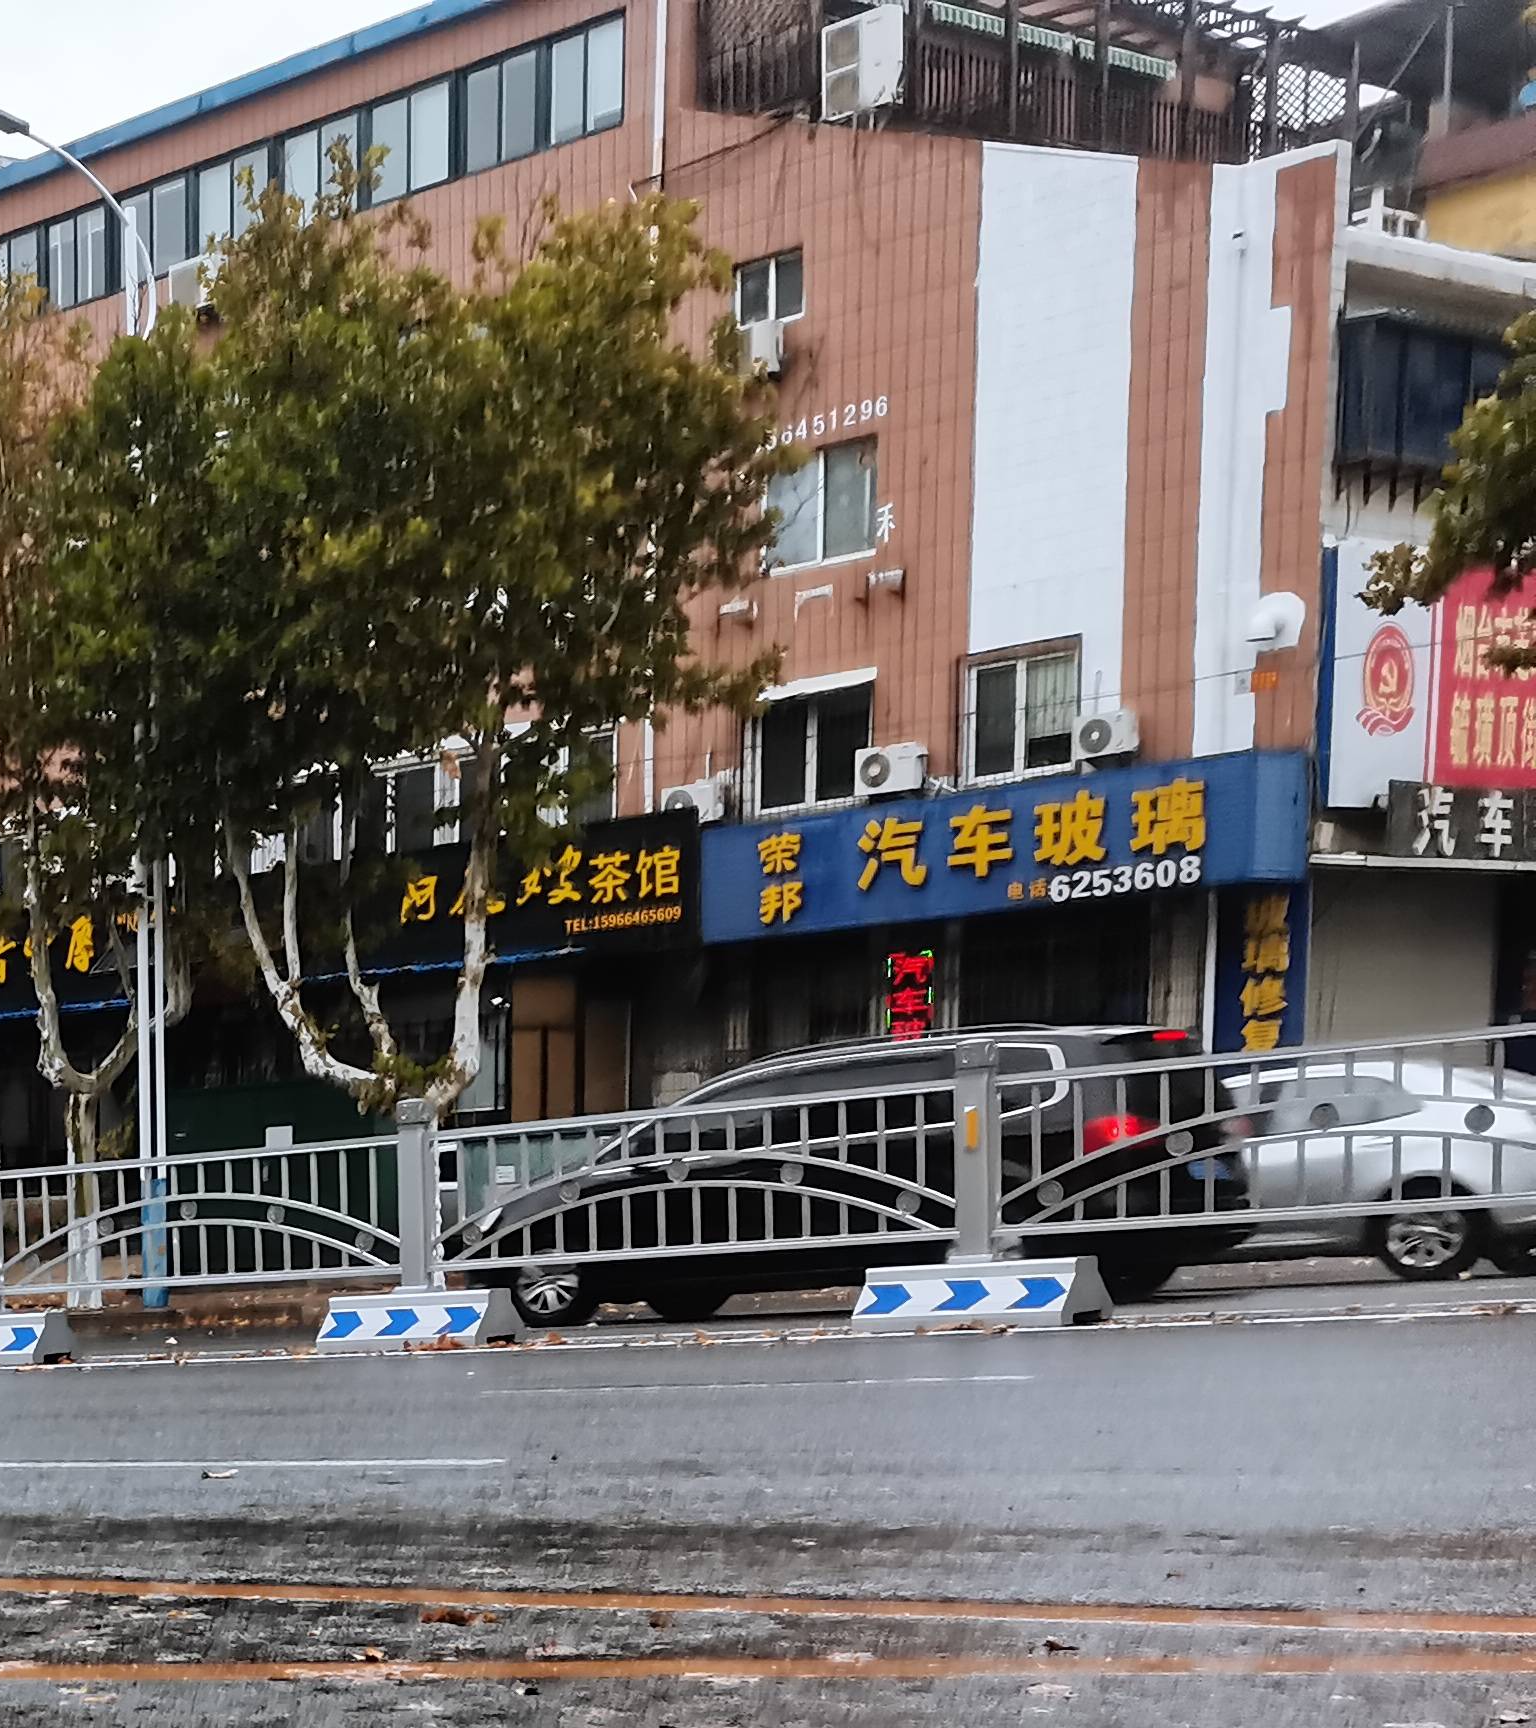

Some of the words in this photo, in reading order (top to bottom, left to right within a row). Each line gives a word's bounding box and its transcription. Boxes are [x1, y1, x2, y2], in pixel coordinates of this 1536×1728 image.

[857, 778, 1206, 892] 汽车玻璃
[1412, 786, 1515, 858] 汽车
[757, 832, 803, 925] 荣邦
